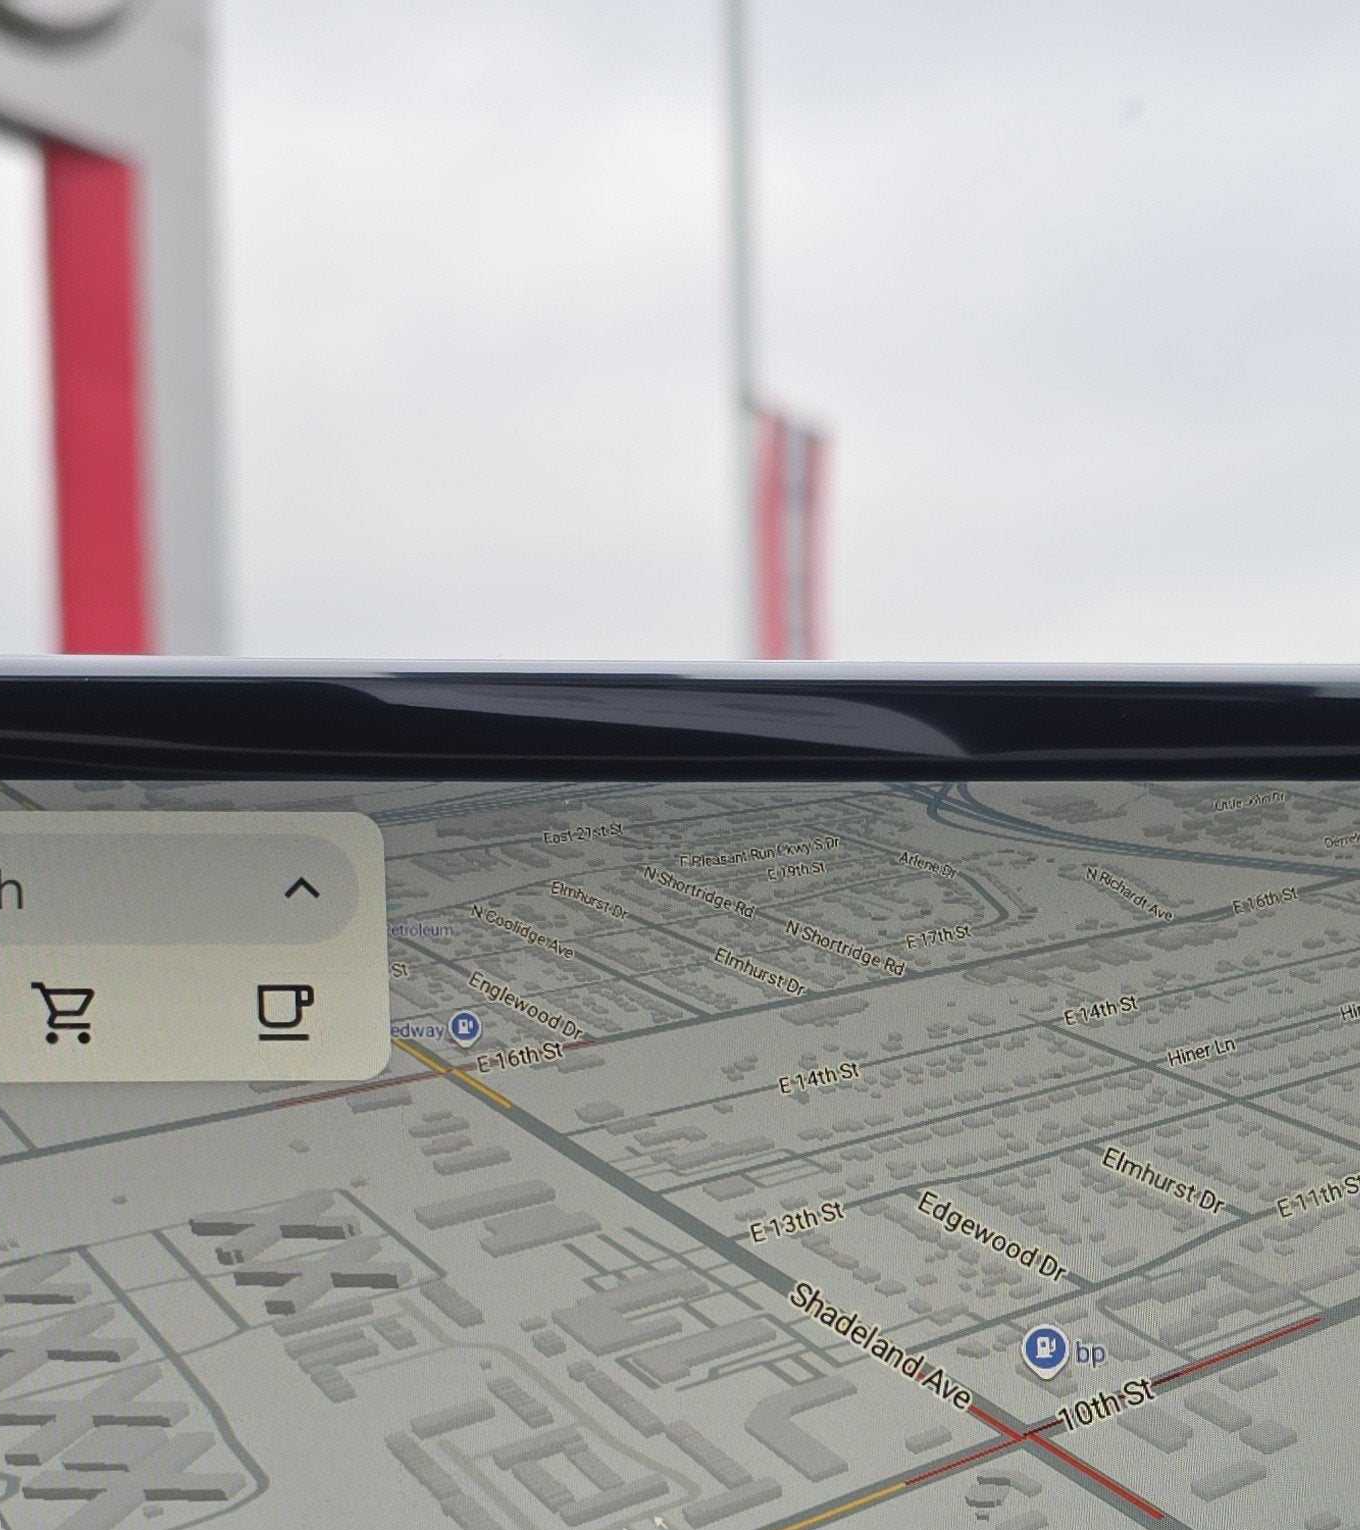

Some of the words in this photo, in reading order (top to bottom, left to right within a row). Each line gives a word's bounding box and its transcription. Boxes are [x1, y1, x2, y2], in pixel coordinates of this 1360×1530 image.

[750, 847, 775, 861] Run
[768, 868, 777, 880] E
[812, 862, 826, 873] St
[898, 851, 941, 874] Arlene
[551, 881, 611, 912] Elmhurst
[611, 904, 629, 919] Dr
[643, 866, 656, 880] N
[658, 870, 732, 910] Shortridge
[735, 901, 756, 918] Rd
[1086, 867, 1098, 882] N
[1150, 904, 1175, 922] Ave
[1233, 900, 1244, 914] E
[1247, 892, 1279, 911] 16th
[1282, 887, 1298, 901] St
[471, 905, 483, 919] N
[485, 909, 547, 947] Coolidge
[549, 940, 575, 960] Ave
[786, 921, 800, 936] N
[801, 926, 881, 966] Shortridge
[882, 956, 906, 977] Rd
[906, 934, 917, 949] E
[919, 927, 952, 947] 17th
[954, 924, 972, 940] St
[391, 963, 408, 977] St
[715, 947, 785, 993] Elmhurst
[786, 977, 807, 997] Dr
[469, 971, 563, 1029] Englewood
[563, 1019, 583, 1039] Dr
[1064, 1010, 1076, 1026] E
[1079, 1001, 1117, 1023] 14th
[1118, 995, 1139, 1014] St
[478, 1055, 490, 1072] E
[496, 1047, 540, 1068] 16th
[543, 1041, 563, 1059] St
[1168, 1042, 1214, 1066] Hiner
[1215, 1036, 1237, 1055] Ln
[779, 1075, 792, 1094] E
[794, 1064, 838, 1090] 14th
[839, 1060, 861, 1080] St
[1102, 1147, 1197, 1206] Elmhurst
[1198, 1189, 1224, 1214] Dr
[1277, 1199, 1290, 1218] E
[1295, 1182, 1342, 1213] 11th
[750, 1222, 763, 1242] E
[769, 1209, 819, 1237] 13th
[821, 1202, 844, 1222] St
[918, 1191, 1038, 1268] Edgewood
[1039, 1254, 1067, 1283] Dr
[790, 1283, 921, 1380] Shadeland
[921, 1369, 972, 1410] Ave
[1076, 1341, 1106, 1367] bp
[1058, 1391, 1121, 1431] 10th
[1124, 1378, 1155, 1405] St
